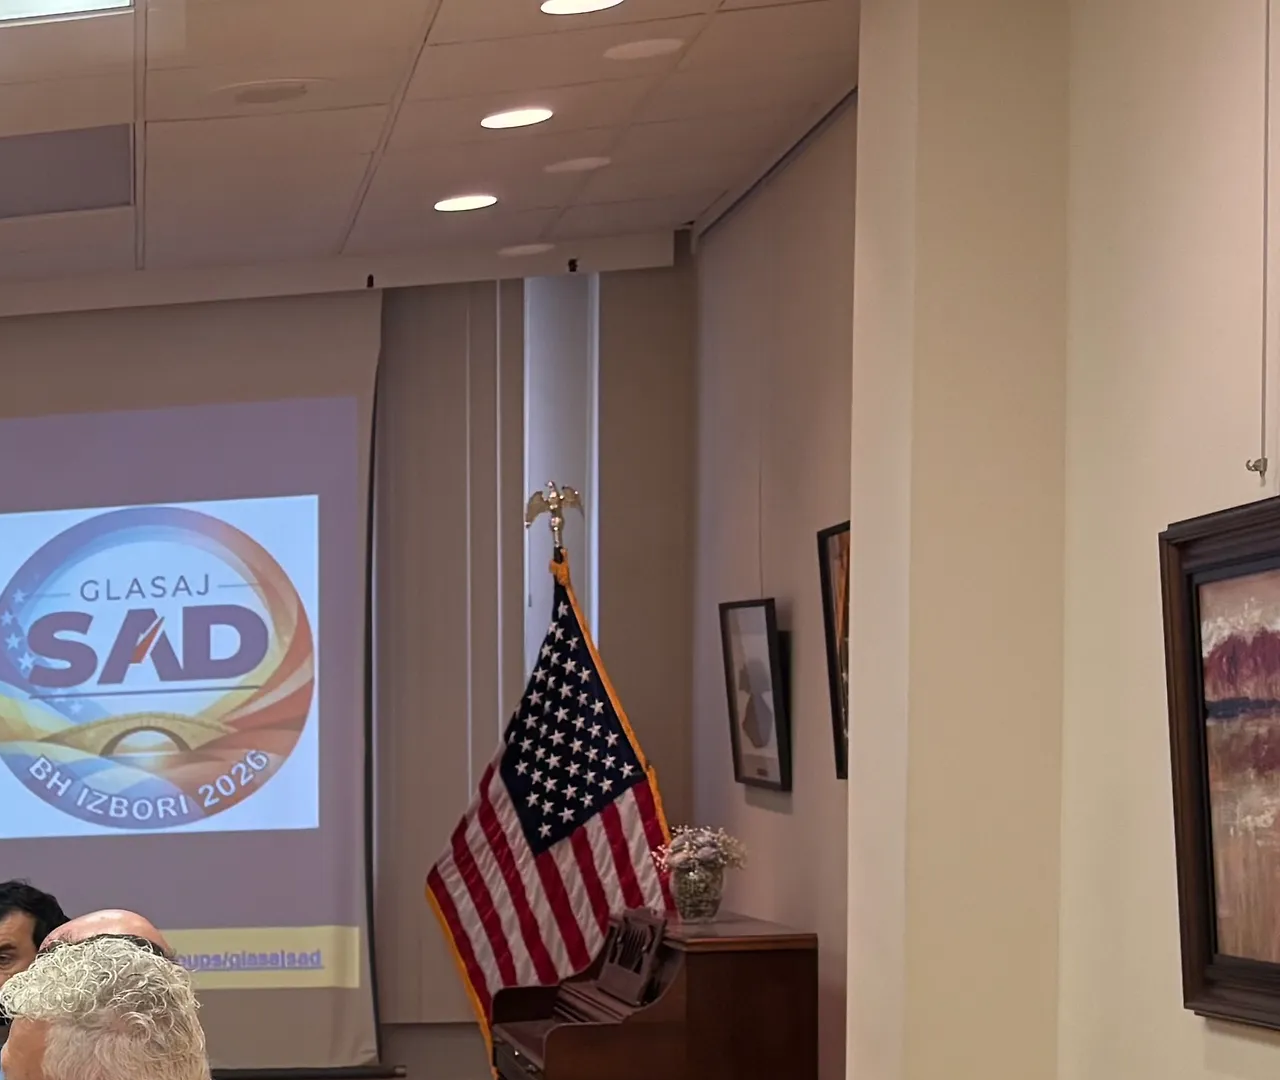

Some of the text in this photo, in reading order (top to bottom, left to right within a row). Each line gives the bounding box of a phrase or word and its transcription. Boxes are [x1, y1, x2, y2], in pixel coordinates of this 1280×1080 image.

[79, 574, 211, 602] GLASAJ
[25, 603, 270, 688] SAD
[27, 748, 269, 821] BH IZBORI 2026
